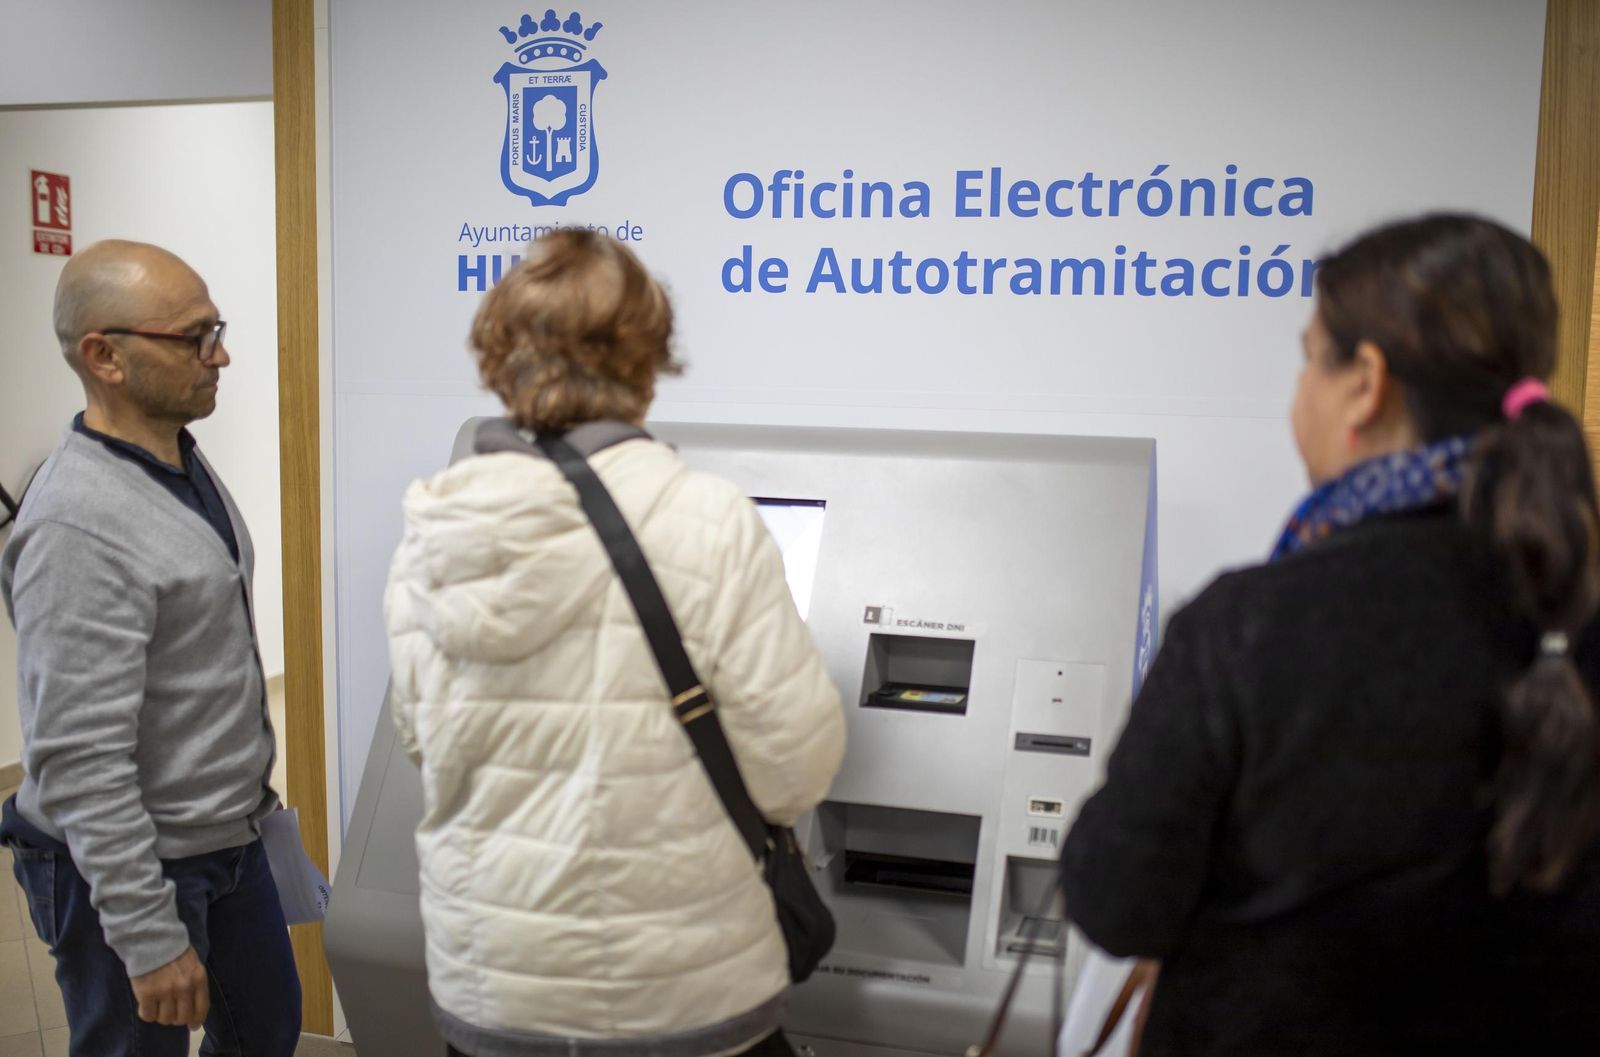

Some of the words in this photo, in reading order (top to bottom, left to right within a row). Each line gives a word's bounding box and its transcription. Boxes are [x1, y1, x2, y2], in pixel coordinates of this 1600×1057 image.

[528, 76, 539, 85] ET
[512, 93, 520, 124] MARIS
[579, 103, 587, 152] CUSTODIA
[512, 127, 520, 166] PORTUS
[723, 168, 931, 220] Oficina
[954, 163, 1314, 218] Electrónica
[617, 220, 643, 241] de
[720, 243, 790, 295] de
[805, 243, 1325, 299] Autotramitación
[896, 618, 945, 631] ESCÁNER
[946, 623, 966, 633] DNI
